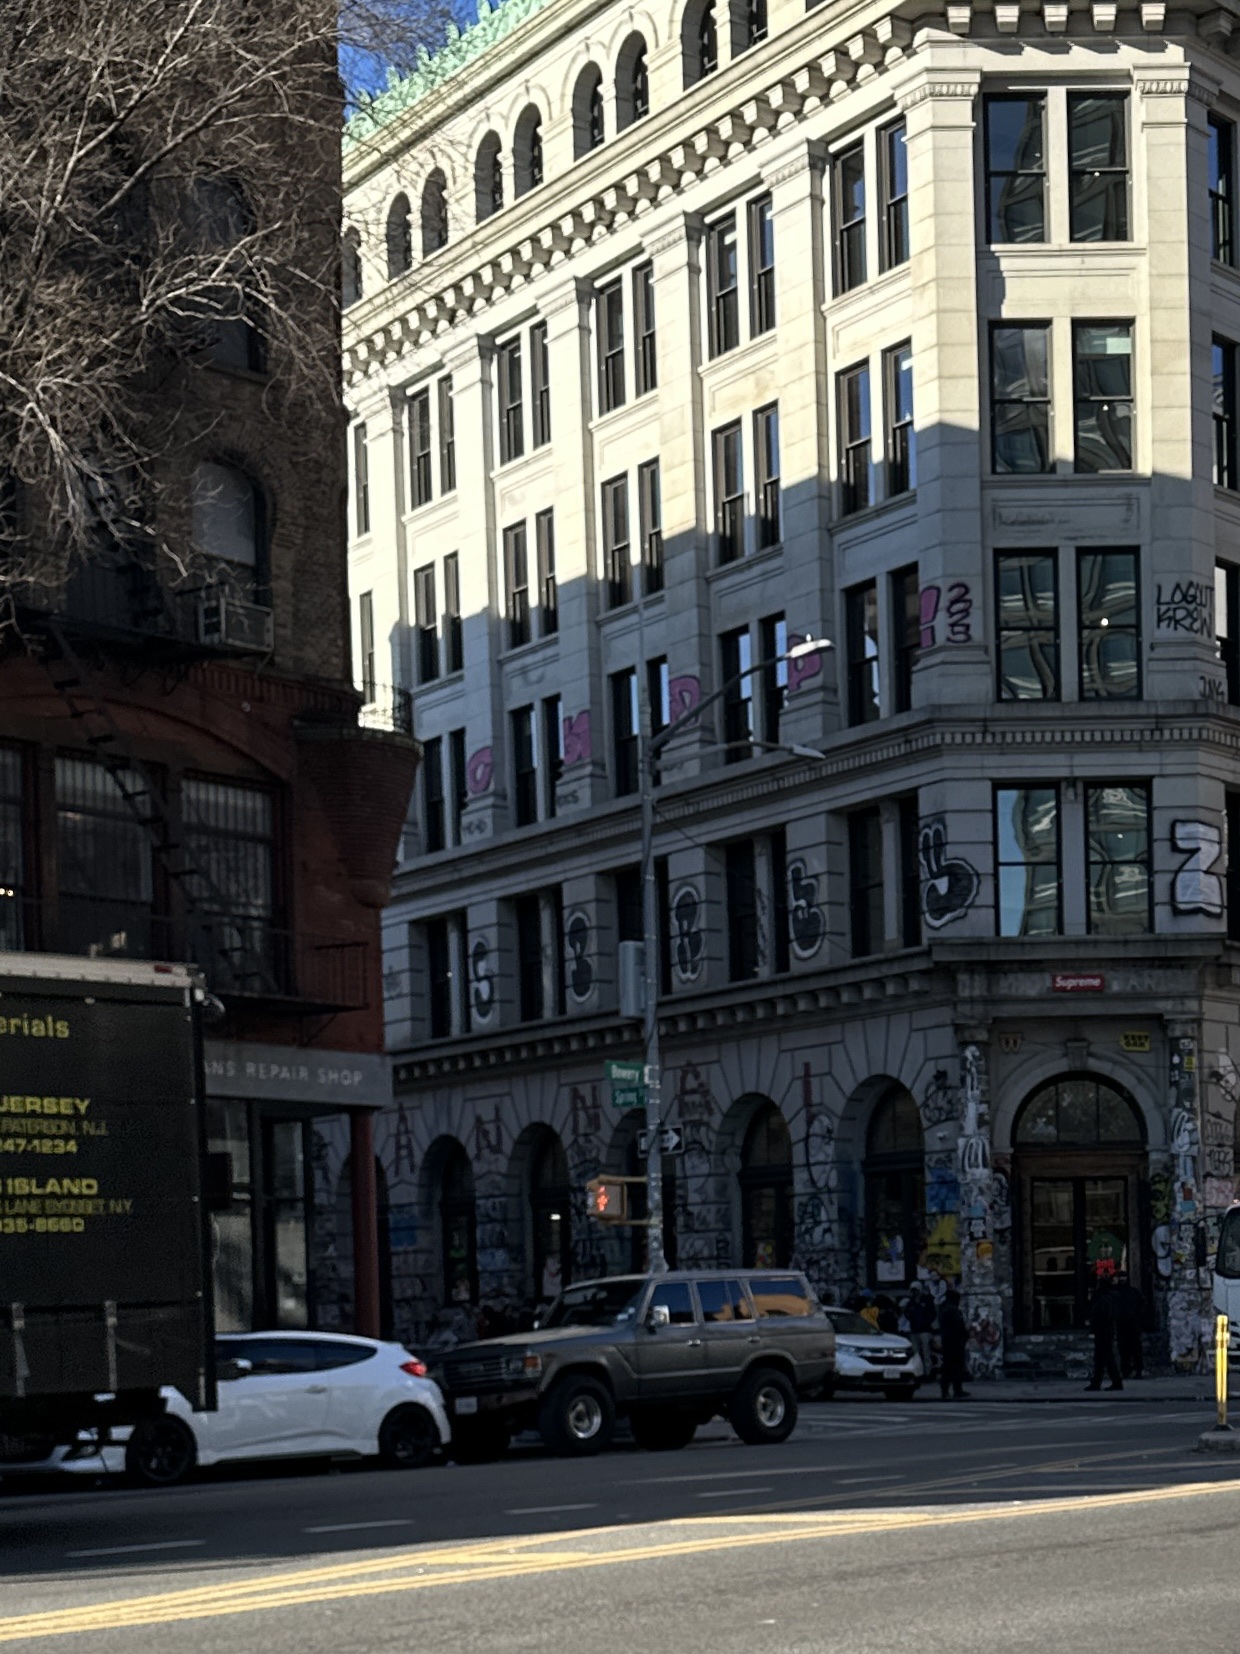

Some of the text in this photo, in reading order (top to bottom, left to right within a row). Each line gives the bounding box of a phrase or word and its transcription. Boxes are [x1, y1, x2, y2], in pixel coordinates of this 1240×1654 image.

[1055, 976, 1101, 990] Supreme
[246, 1061, 309, 1081] REPAIR
[317, 1067, 363, 1086] SHOP
[6, 1178, 98, 1197] ISLAND
